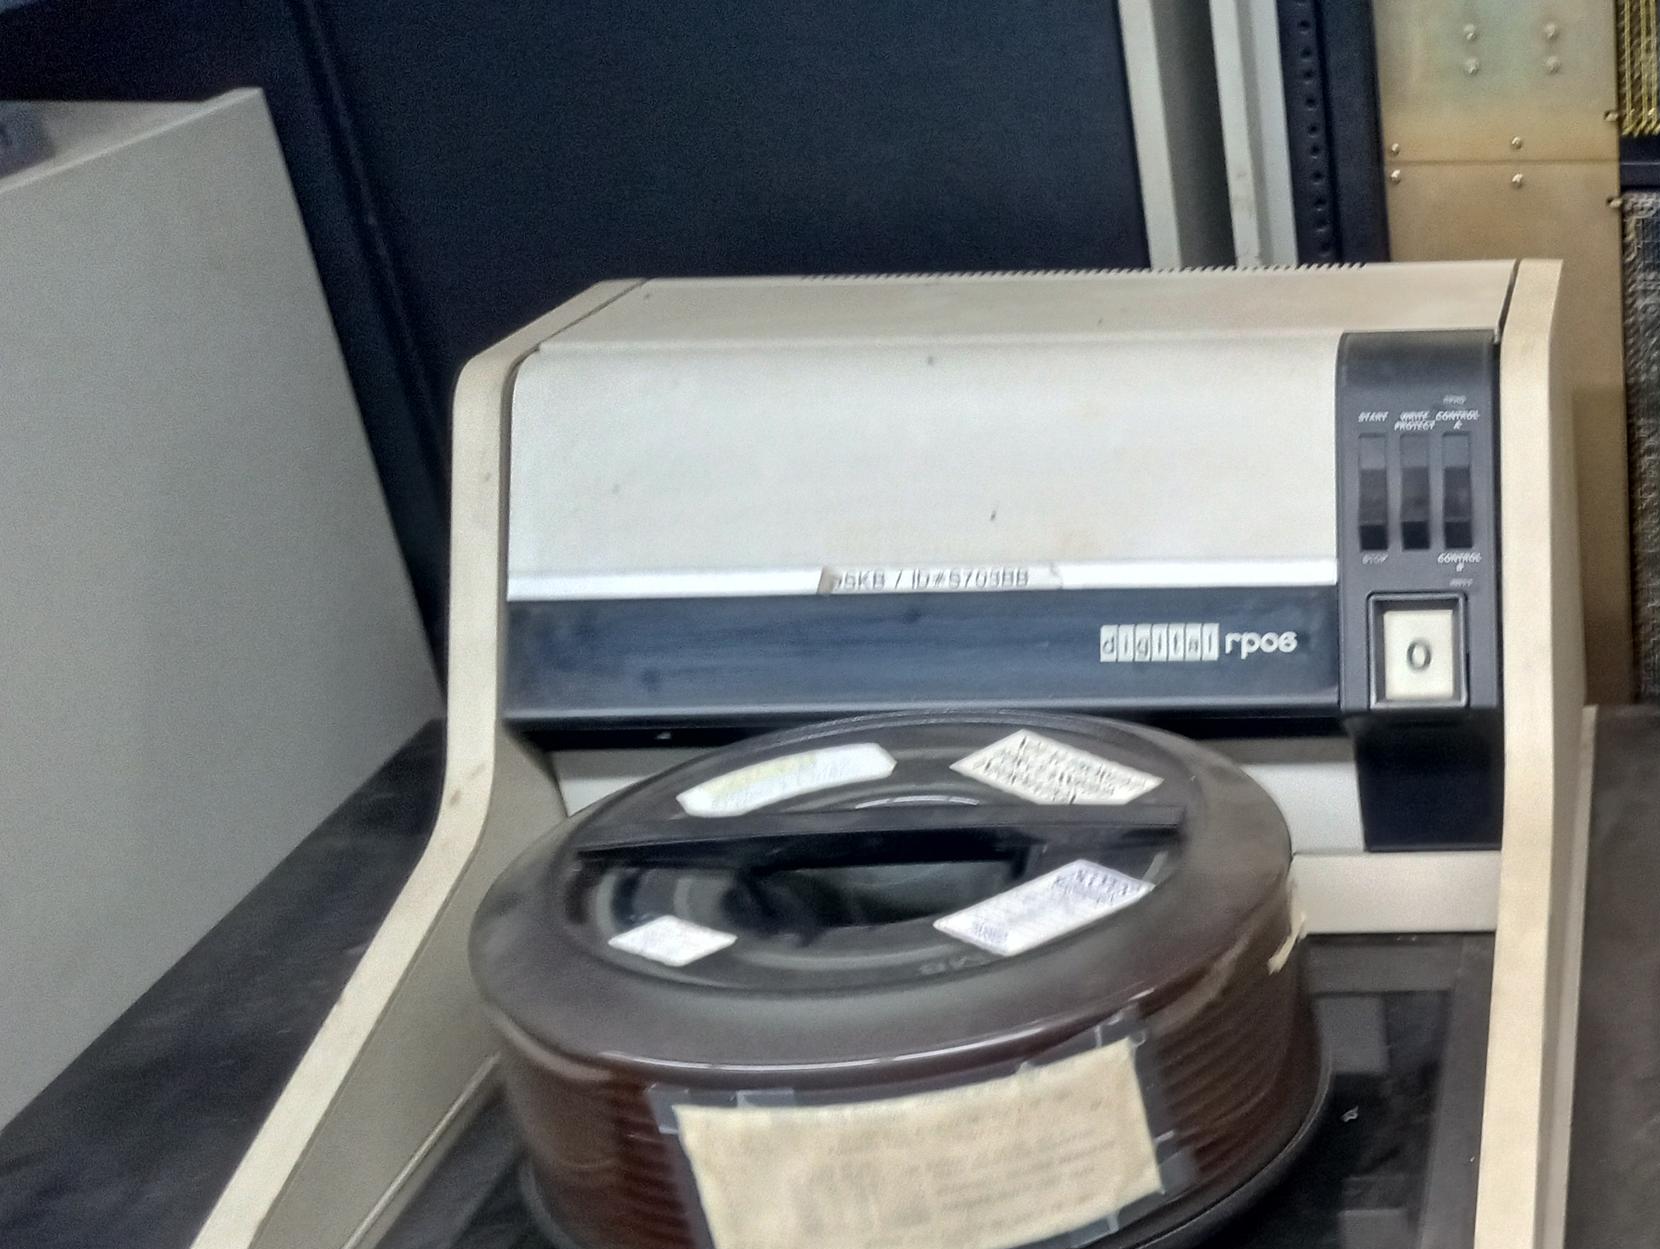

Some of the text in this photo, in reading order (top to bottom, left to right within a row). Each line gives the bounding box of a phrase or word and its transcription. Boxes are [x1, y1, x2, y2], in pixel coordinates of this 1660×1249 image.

[1358, 411, 1389, 422] START
[1100, 623, 1219, 662] digital
[1406, 638, 1432, 672] 0
